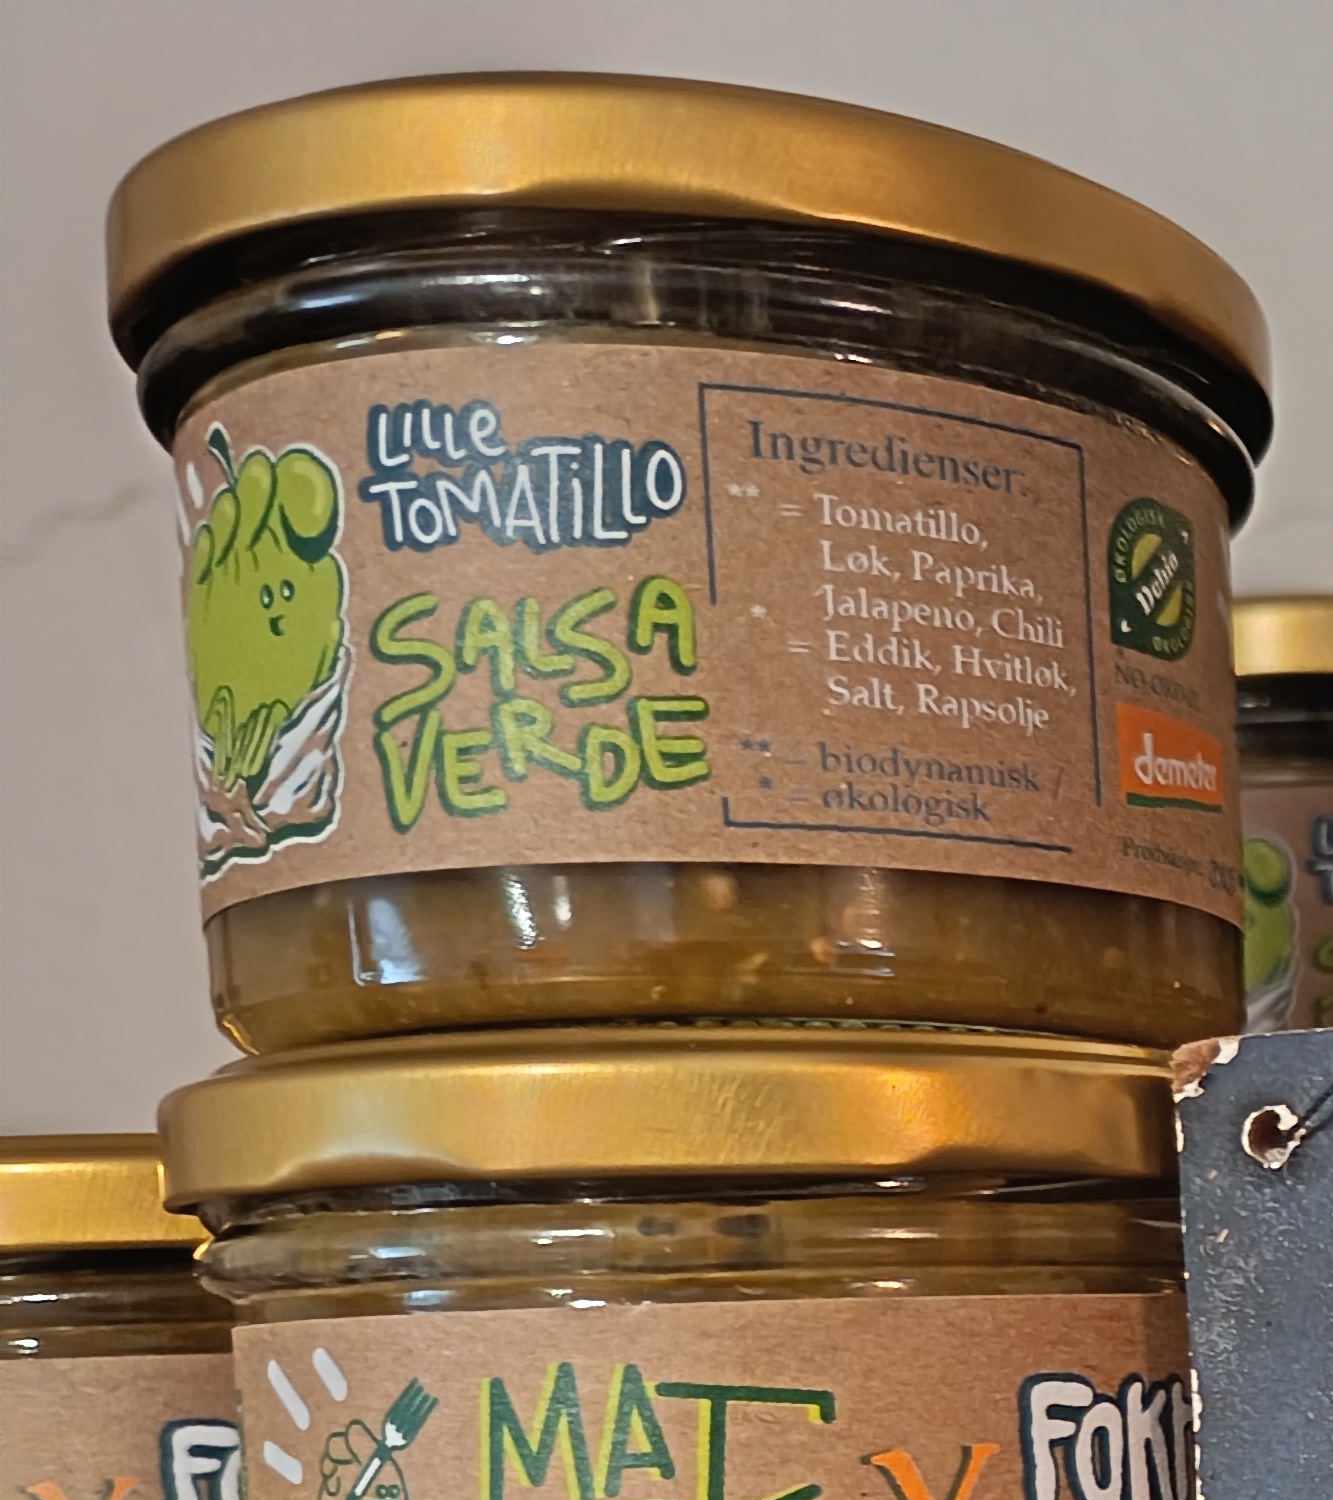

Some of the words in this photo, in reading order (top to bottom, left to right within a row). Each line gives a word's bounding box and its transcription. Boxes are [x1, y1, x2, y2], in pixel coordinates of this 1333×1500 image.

[814, 493, 989, 550] Tomatillo,
[911, 549, 1043, 604] Paprika,
[813, 584, 983, 637] Jalapeno,
[991, 608, 1066, 649] Chili
[370, 576, 697, 730] SALSA
[825, 630, 942, 676] Eddik,
[828, 675, 904, 715] Salt,
[917, 683, 1049, 737] Rapsolje
[374, 697, 710, 833] VERDE
[815, 741, 1040, 793] biodynamisk
